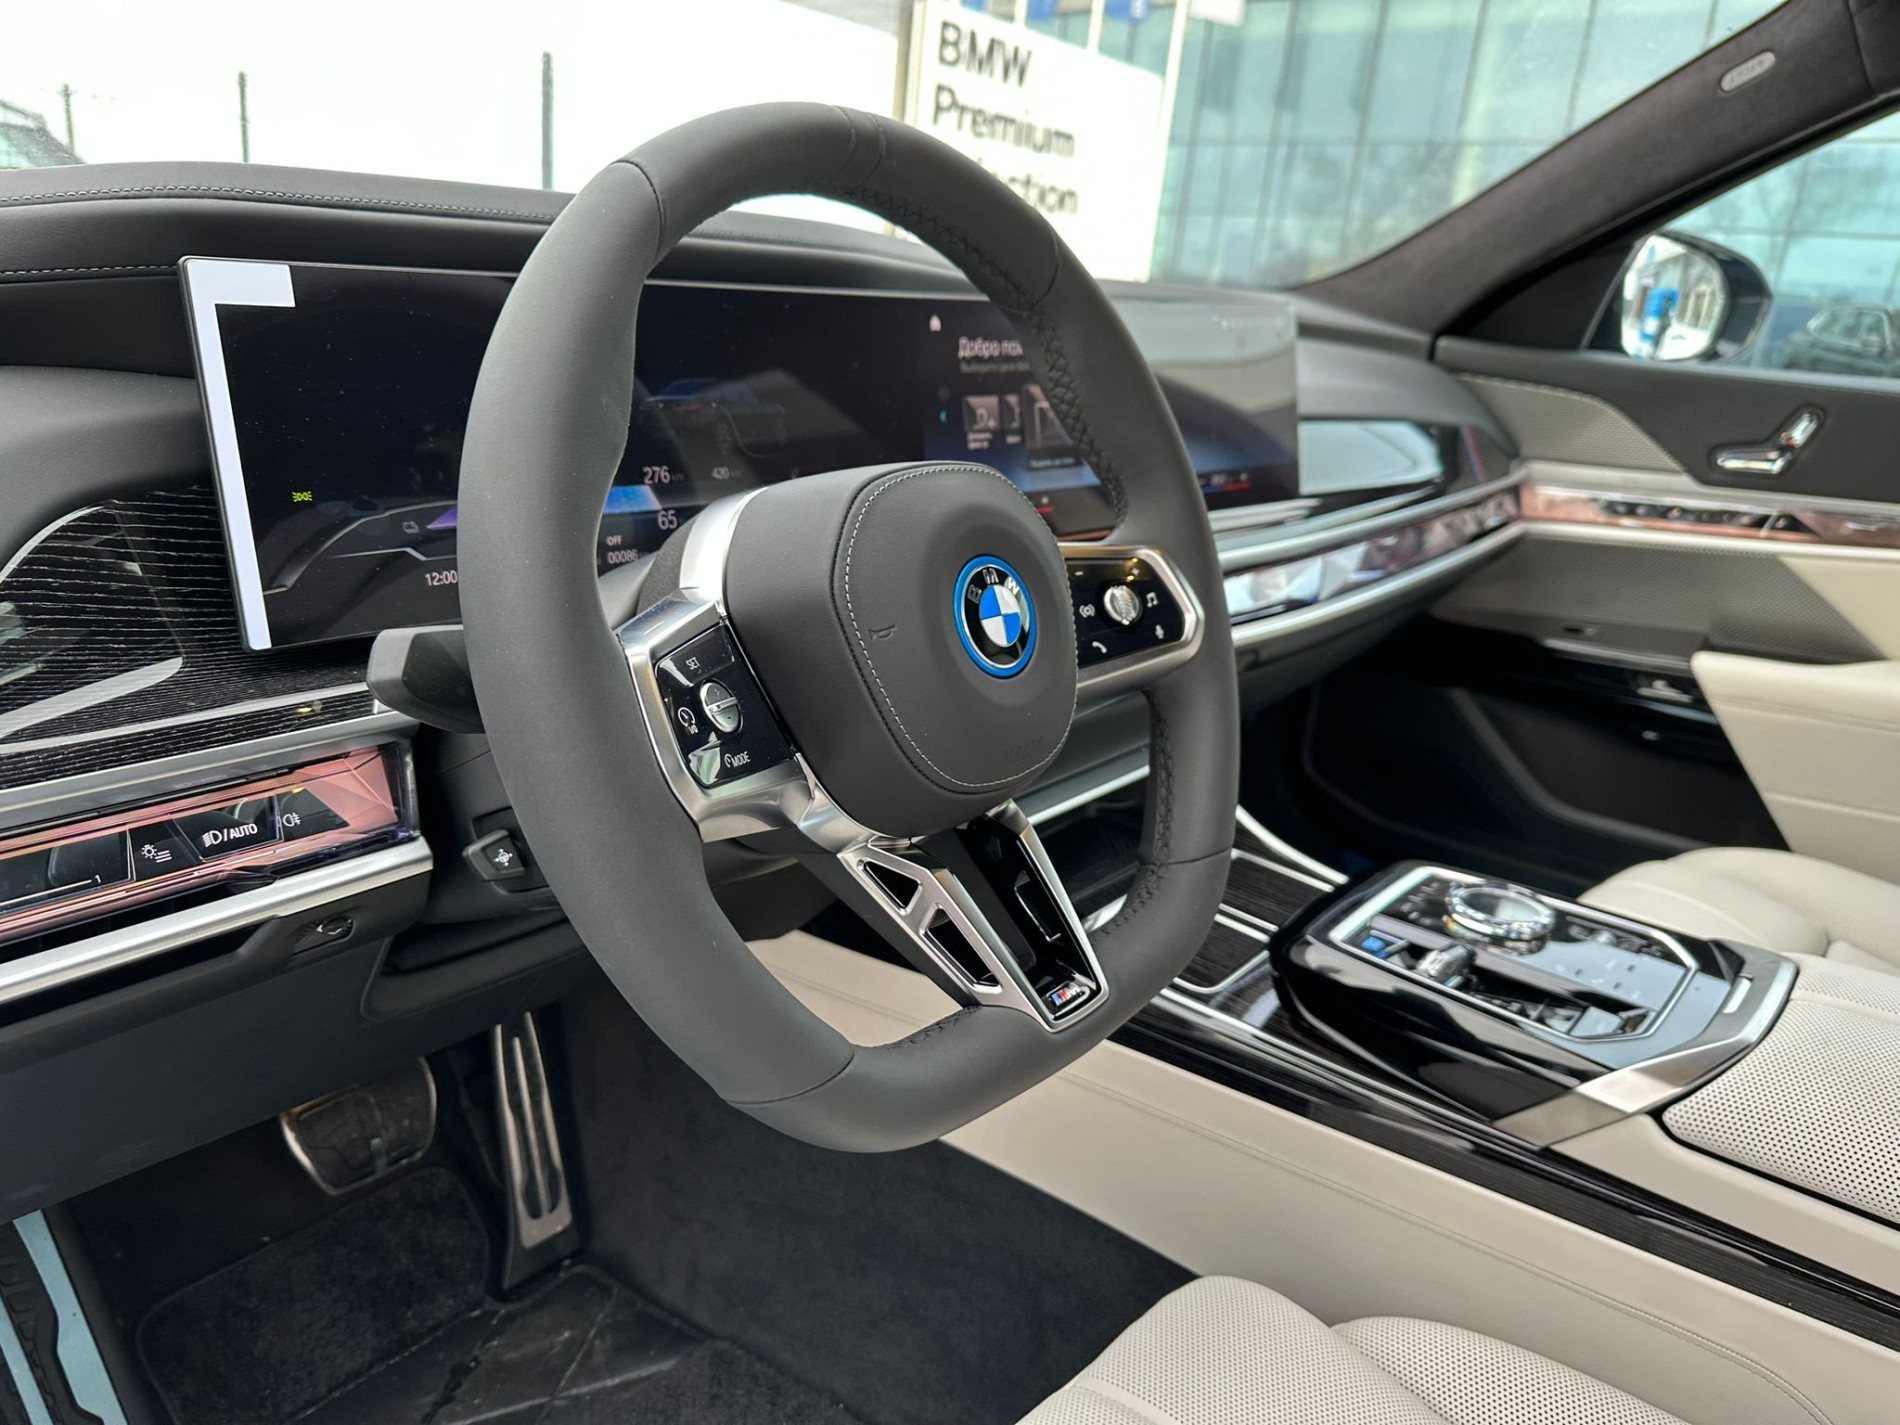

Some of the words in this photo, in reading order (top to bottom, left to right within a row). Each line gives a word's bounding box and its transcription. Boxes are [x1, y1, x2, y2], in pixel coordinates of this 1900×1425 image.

[938, 19, 1032, 88] BMW
[932, 82, 1075, 158] Premium
[642, 465, 670, 484] 276
[658, 510, 677, 530] 65
[425, 570, 457, 586] 12:00
[966, 567, 1020, 604] BMW
[685, 656, 700, 670] SET
[731, 751, 750, 767] MODE
